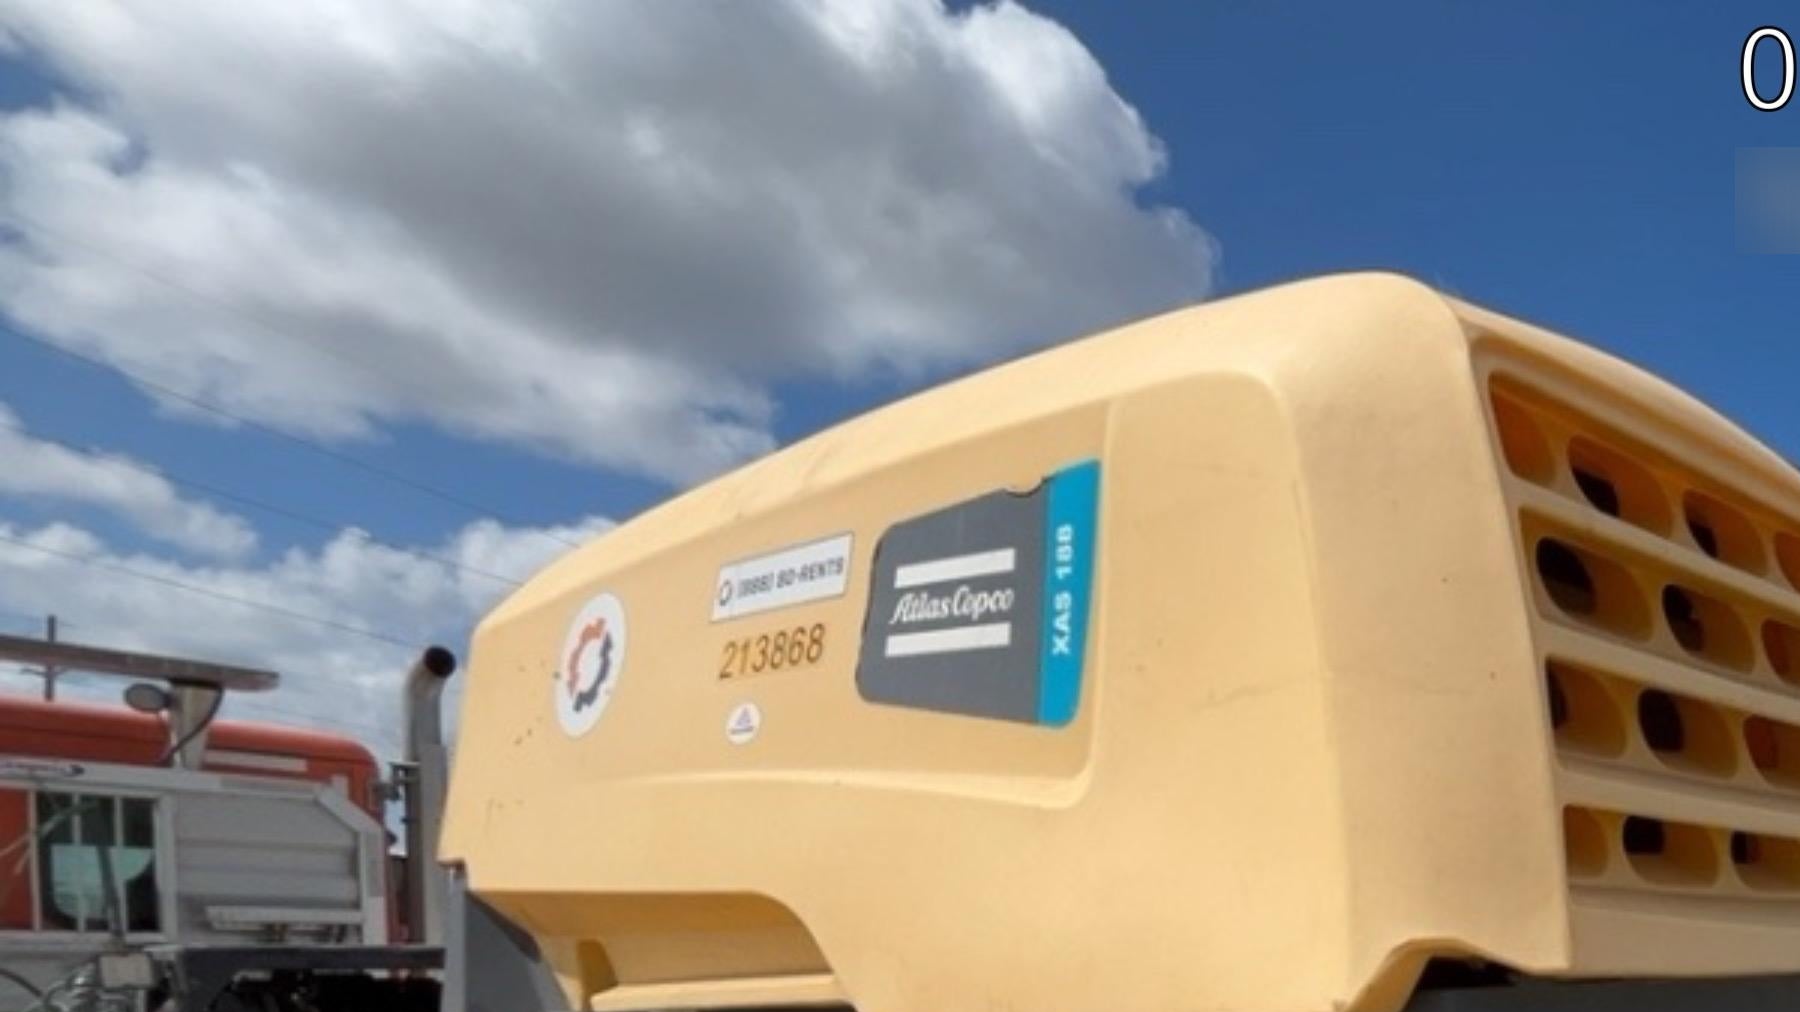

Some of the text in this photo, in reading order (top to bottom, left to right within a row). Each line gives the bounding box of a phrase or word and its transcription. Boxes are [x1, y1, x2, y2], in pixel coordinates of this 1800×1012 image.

[889, 584, 1016, 626] Atlas Copco
[1052, 590, 1073, 656] XAS
[719, 622, 826, 680] 213868
